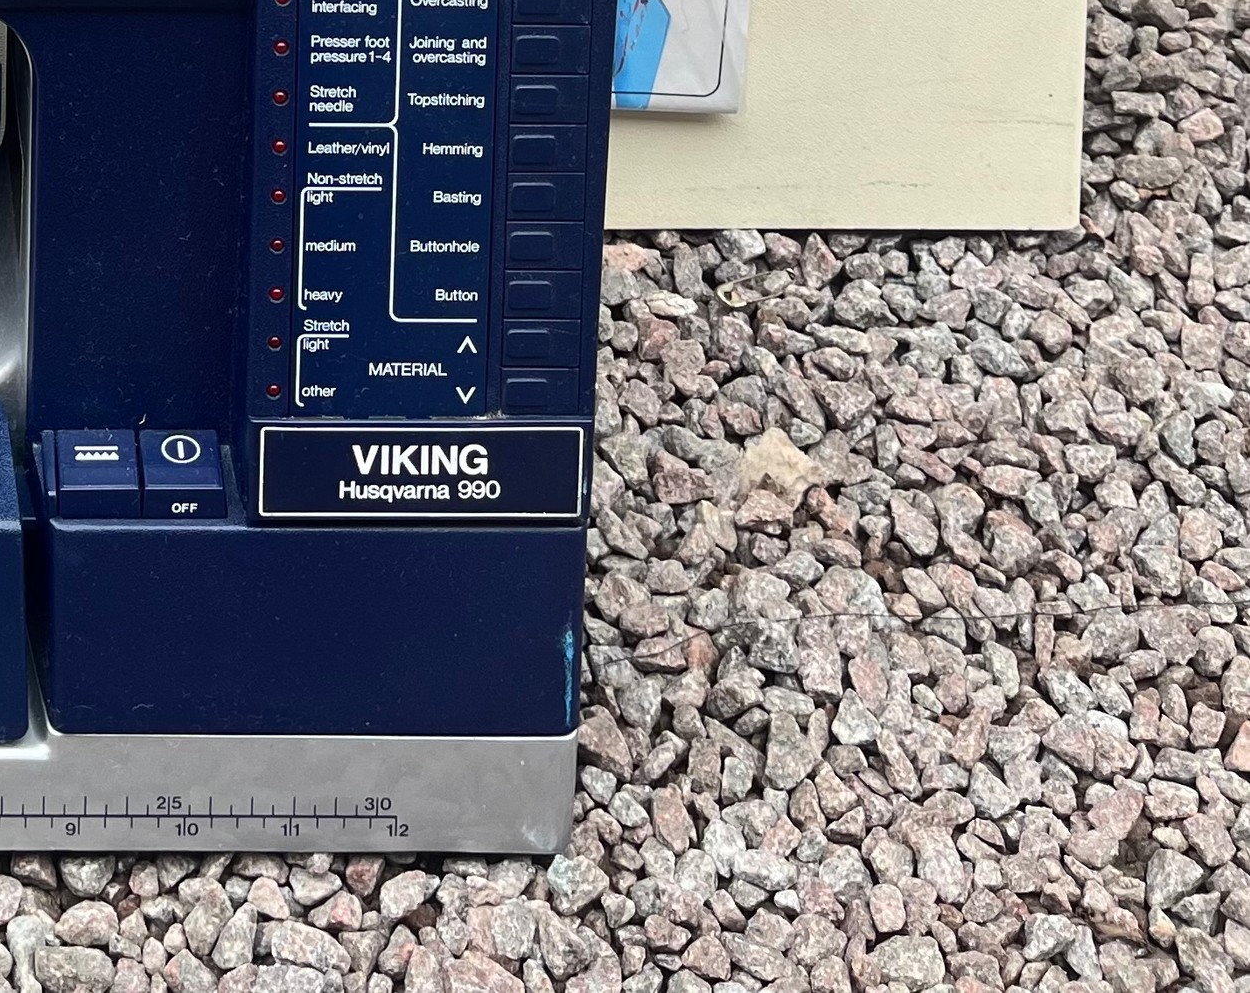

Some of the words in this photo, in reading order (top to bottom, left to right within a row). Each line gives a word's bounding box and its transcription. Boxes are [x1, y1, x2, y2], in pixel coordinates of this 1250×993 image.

[312, 0, 377, 15] interfacing
[311, 35, 360, 47] Presser
[365, 35, 390, 48] foot
[409, 36, 454, 51] Joining
[462, 37, 487, 49] and
[311, 53, 367, 64] pressure
[413, 52, 486, 66] overcasting
[310, 86, 356, 98] Stretch
[310, 100, 353, 112] needle
[408, 93, 485, 108] Topstitching
[308, 142, 389, 156] Leather/vinyl
[423, 143, 483, 157] Hemming
[307, 173, 382, 184] Non-stretch
[307, 191, 333, 205] light
[434, 191, 481, 205] Basting
[306, 240, 356, 251] medium
[410, 240, 479, 252] Buttonhole
[304, 289, 343, 302] heavy
[436, 289, 478, 301] Button
[304, 319, 349, 331] Stretch
[303, 337, 330, 352] light
[369, 363, 447, 376] MATERIAL
[302, 385, 336, 397] other
[352, 444, 488, 475] VIKING
[339, 481, 450, 503] Husqvarna
[458, 480, 500, 499] 990
[172, 503, 198, 513] OFF
[64, 822, 77, 837] 9
